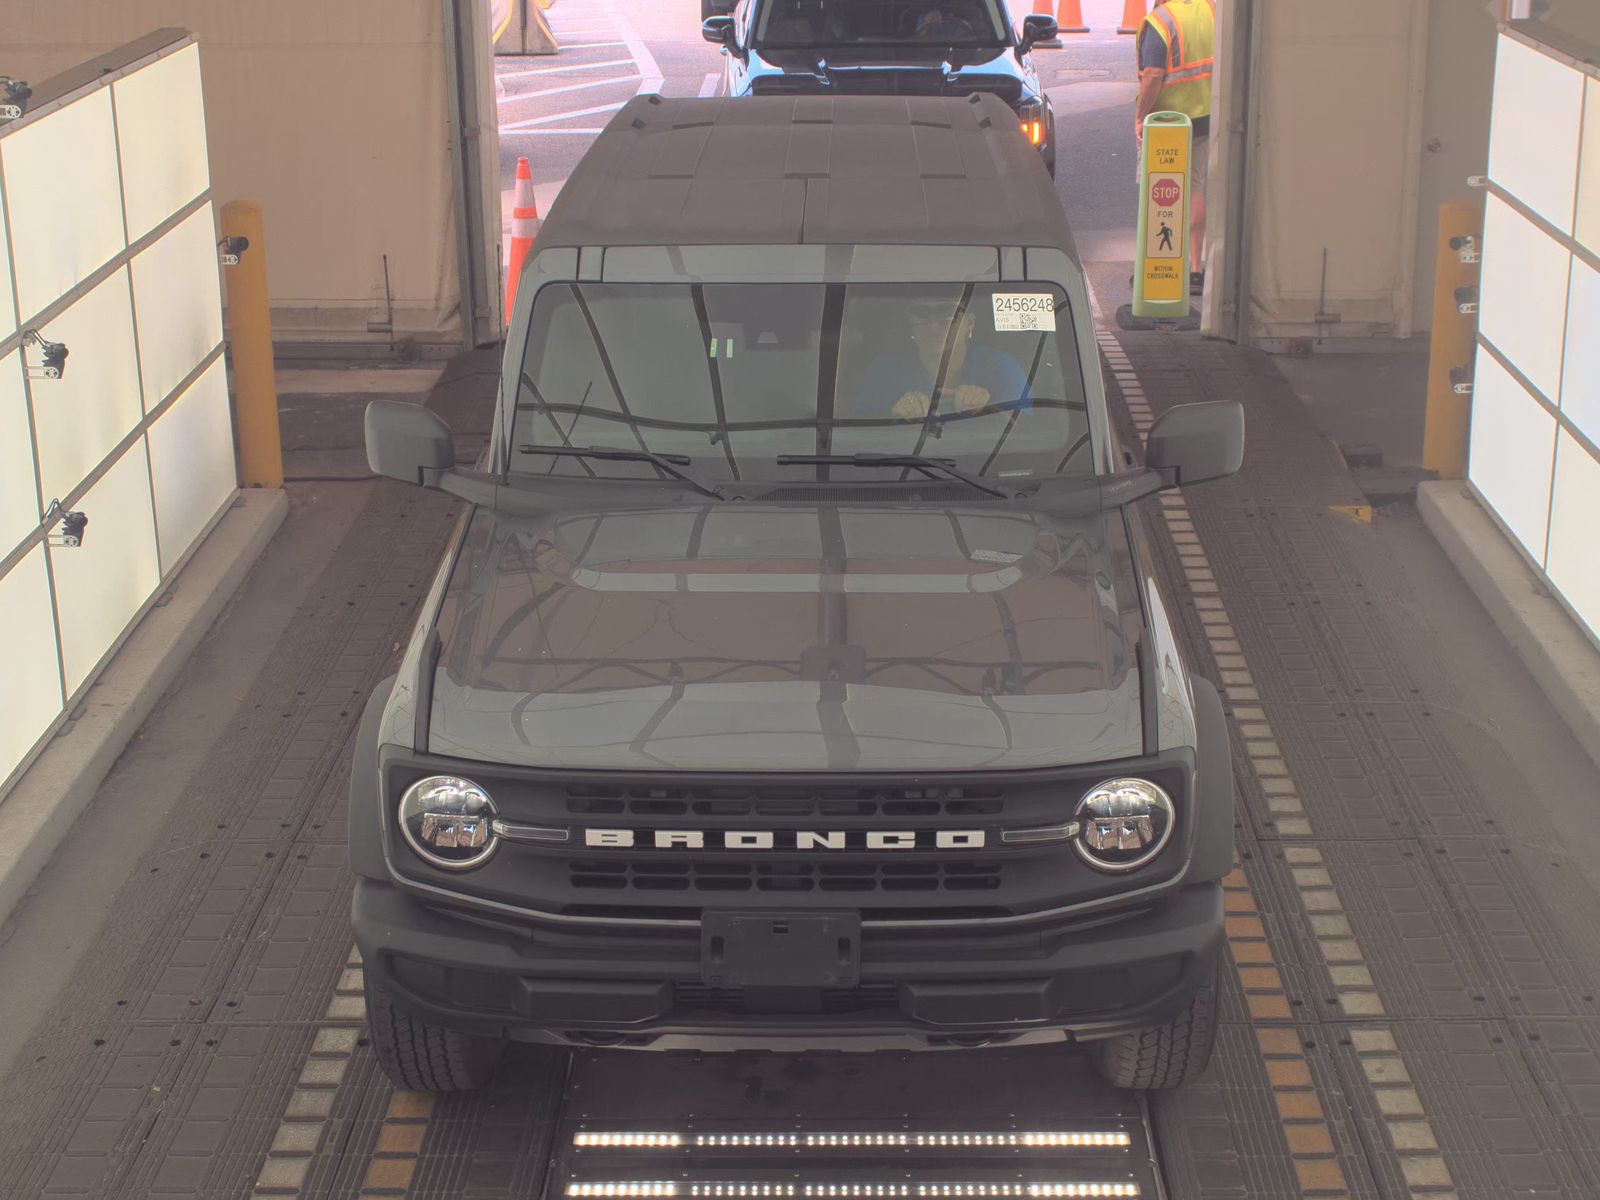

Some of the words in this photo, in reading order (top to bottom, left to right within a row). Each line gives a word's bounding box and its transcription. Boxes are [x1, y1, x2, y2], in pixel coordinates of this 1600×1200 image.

[1153, 187, 1179, 199] STOP
[995, 297, 1055, 312] 2456248
[585, 828, 985, 849] BRONCO
